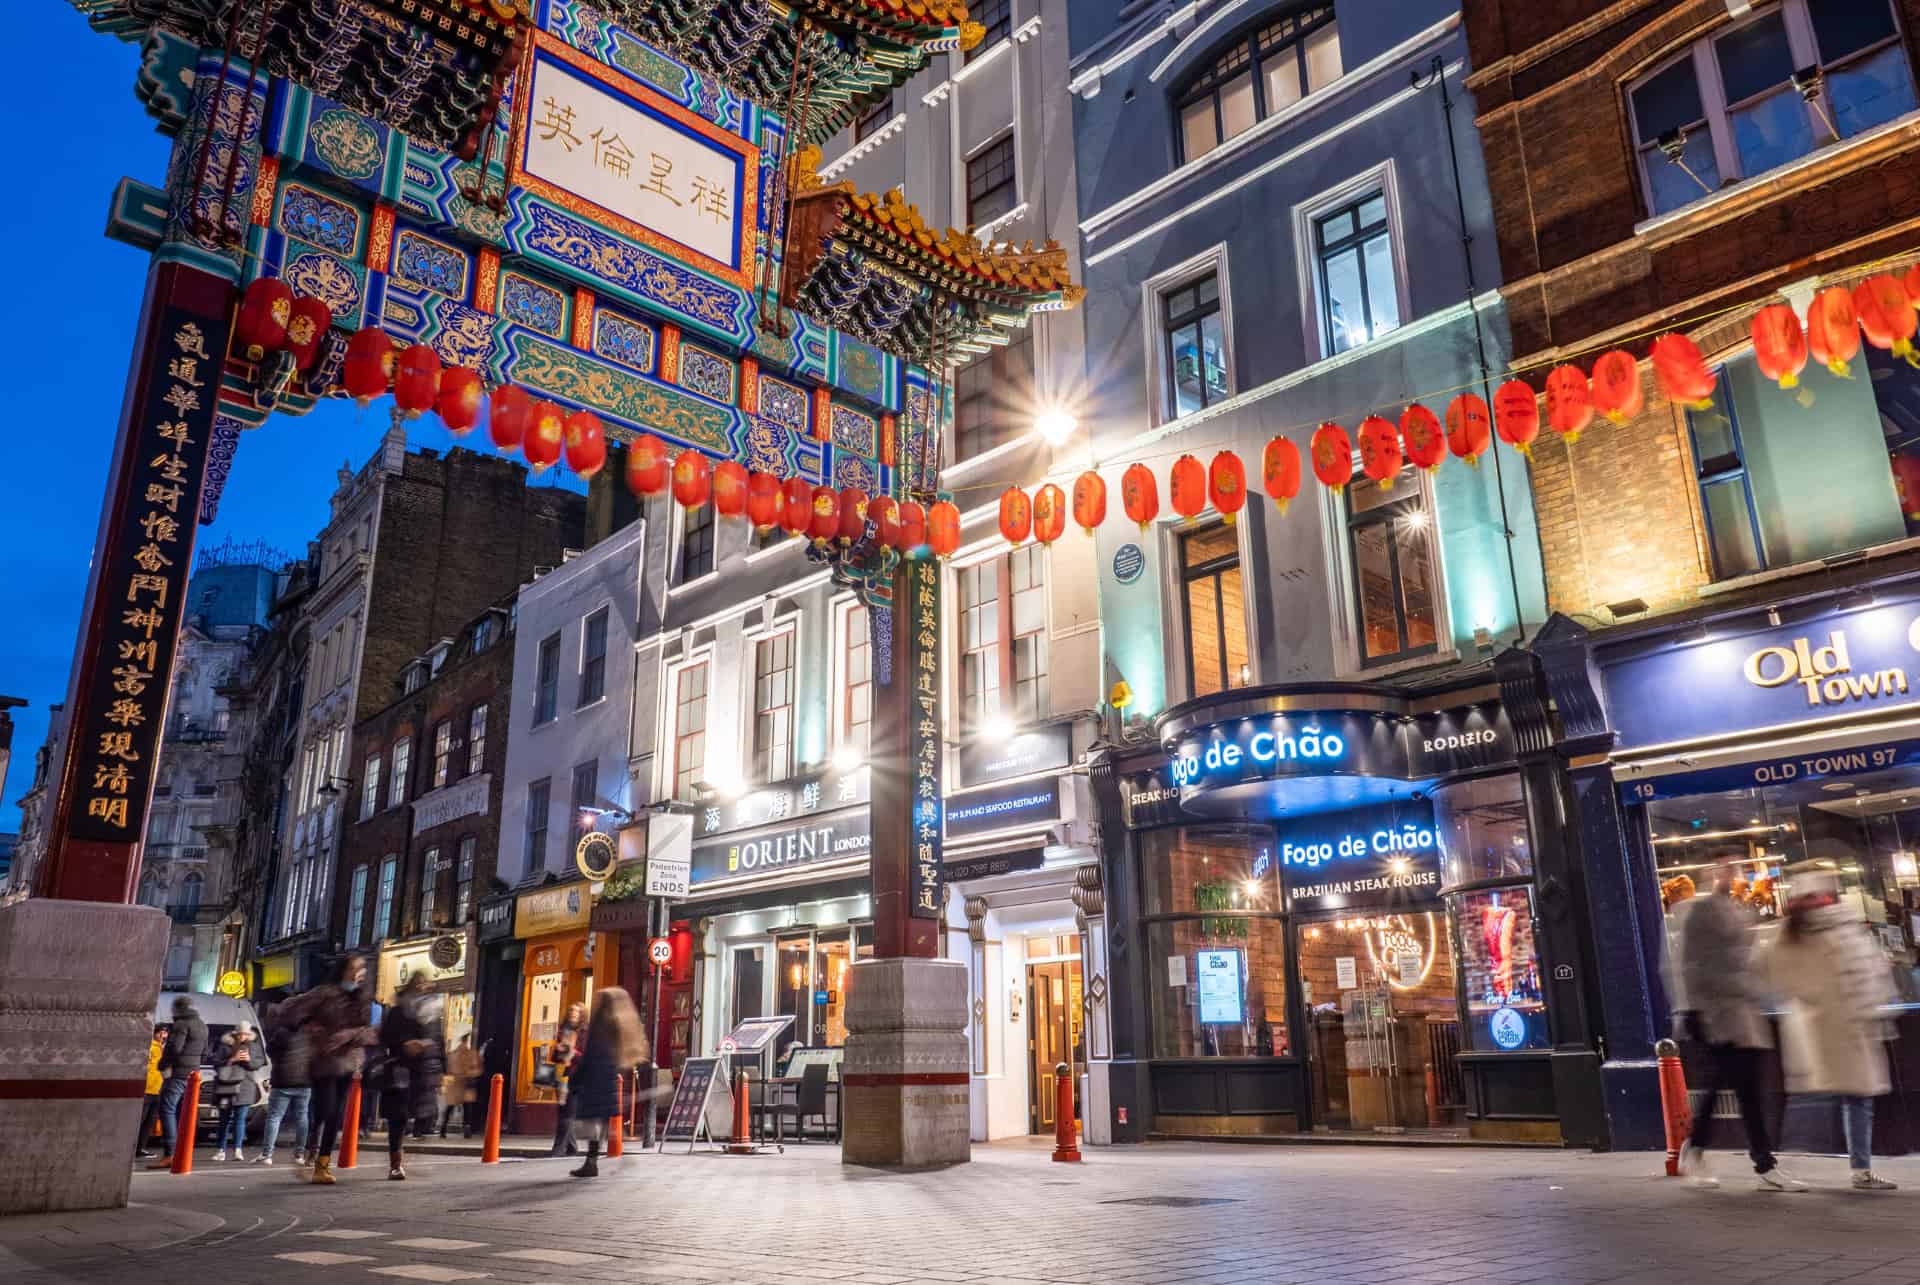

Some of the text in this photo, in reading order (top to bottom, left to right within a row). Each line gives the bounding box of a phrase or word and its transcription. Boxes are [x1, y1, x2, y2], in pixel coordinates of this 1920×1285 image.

[535, 96, 731, 225] 英倫呈祥
[1744, 631, 1851, 687] Old
[1798, 667, 1908, 705] Town
[1205, 739, 1241, 768] de
[1251, 727, 1343, 761] Chão
[1423, 729, 1496, 753] RODIZIO
[1754, 749, 1897, 783] OLD TOWN 97
[984, 801, 1012, 814] SEAFOOD
[1013, 793, 1052, 808] RESTAURANT
[1131, 790, 1161, 805] STEAK
[1634, 784, 1655, 799] 19
[742, 827, 834, 869] ORIENT
[1283, 843, 1333, 866] Fogo
[1338, 834, 1367, 857] de
[1372, 825, 1433, 852] Chão
[650, 862, 688, 872] Pedestrian
[660, 871, 677, 879] Zone
[652, 881, 684, 893] ENDS
[1292, 872, 1437, 899] BRAZILIAN STEAK HOUSE
[654, 946, 669, 957] 20
[1560, 968, 1569, 977] 17
